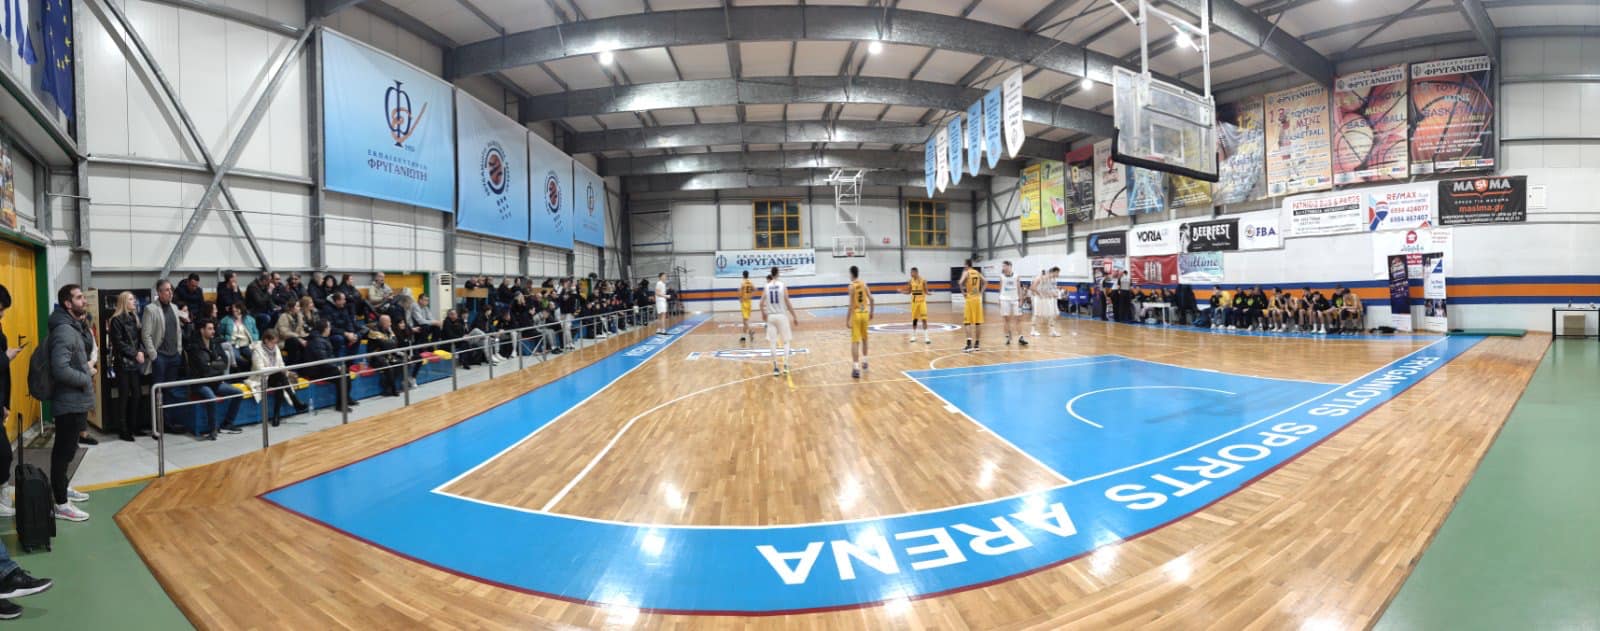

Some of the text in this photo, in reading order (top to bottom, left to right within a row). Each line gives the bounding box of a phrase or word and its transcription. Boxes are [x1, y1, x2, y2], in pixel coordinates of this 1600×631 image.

[1424, 62, 1489, 76] ΦΡΥΓΑΝΙΩΤΗ
[367, 158, 428, 182] ΦΡΥΓΑΝΙΩΤΗ
[1192, 223, 1231, 242] BEERFEST
[736, 256, 815, 267] ΦΡΥΓΑΝΙΩΤΗ
[769, 290, 779, 304] 11
[756, 355, 1442, 586] FRYGANIOTIS SPORTS ARENA
